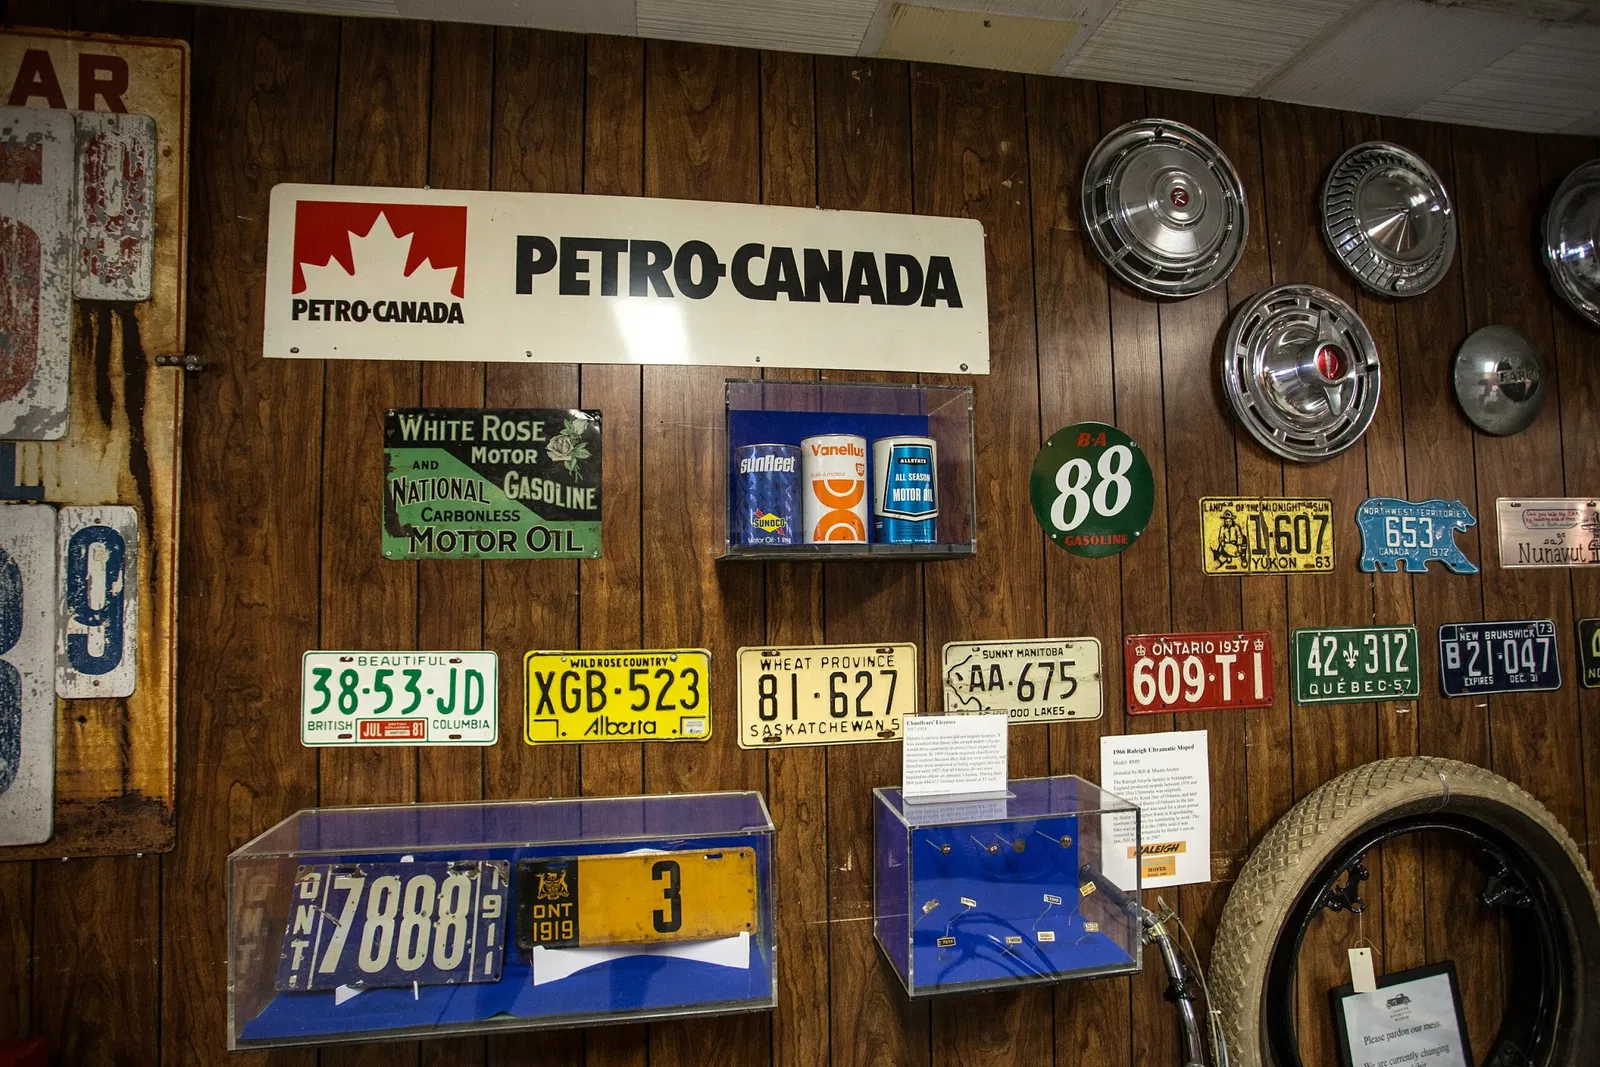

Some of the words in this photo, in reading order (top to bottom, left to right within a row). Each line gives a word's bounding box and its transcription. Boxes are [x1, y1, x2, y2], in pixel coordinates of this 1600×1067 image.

[515, 234, 964, 308] PETRO-CANADA
[291, 298, 465, 324] PETRO-CANADA
[398, 414, 474, 442] WHITE
[482, 415, 546, 442] ROSE
[470, 446, 538, 464] MOTOR
[811, 443, 865, 458] Vanellus
[412, 460, 439, 470] AND
[894, 473, 906, 482] ALL
[908, 473, 931, 482] SEASON
[391, 476, 491, 507] NATIONAL
[504, 470, 598, 510] GASOLINE
[892, 488, 921, 502] MOTOR
[923, 488, 934, 502] OIL
[1050, 444, 1133, 532] 88
[420, 507, 521, 522] CARBONLESS
[1364, 508, 1412, 516] NORTHWEST
[1416, 508, 1468, 518] TERRITORIES
[754, 518, 786, 528] SUNOCO
[408, 526, 519, 554] MOTOR
[525, 524, 585, 554] OIL
[1386, 516, 1434, 548] 653
[1064, 534, 1128, 546] GASOLINE
[1379, 548, 1410, 556] CANADA
[1429, 548, 1450, 556] 1972
[1518, 542, 1586, 564] Nunavut
[1252, 558, 1297, 569] YUKON
[1315, 556, 1331, 568] 63
[67, 526, 125, 676] 9
[1460, 632, 1479, 641] NEW
[1484, 629, 1536, 640] BRUNSWICK
[1540, 624, 1553, 634] 73
[982, 649, 1014, 660] SUNNY
[1016, 648, 1064, 658] MANITOBA
[1152, 640, 1215, 656] ONTARIO
[1219, 640, 1249, 653] 1937
[358, 656, 447, 667] BEAUTIFUL
[570, 658, 595, 669] WILD
[597, 658, 622, 668] ROSE
[623, 657, 669, 668] COUNTRY
[760, 656, 812, 671] WHEAT
[821, 654, 895, 669] PROVINCE
[1464, 676, 1494, 687] EXPIRES
[1510, 674, 1527, 684] DEC.
[1530, 674, 1538, 682] 31
[1034, 706, 1066, 716] LAKES
[308, 720, 353, 731] BRITISH
[432, 719, 490, 730] COLUMBIA
[363, 722, 382, 737] JUL
[412, 722, 424, 736] 81
[584, 714, 657, 736] Alberta
[750, 720, 884, 738] SASKATCHEWAN
[1126, 747, 1147, 755] Raleigh
[652, 860, 682, 933] 3
[533, 902, 573, 919] ONT
[318, 874, 472, 974] 7888
[533, 920, 574, 942] 1919
[1364, 1033, 1385, 1046] Please
[1386, 1028, 1410, 1042] pardon
[1410, 1026, 1422, 1034] our
[1389, 1051, 1420, 1064] currently
[1420, 1043, 1450, 1057] changing
